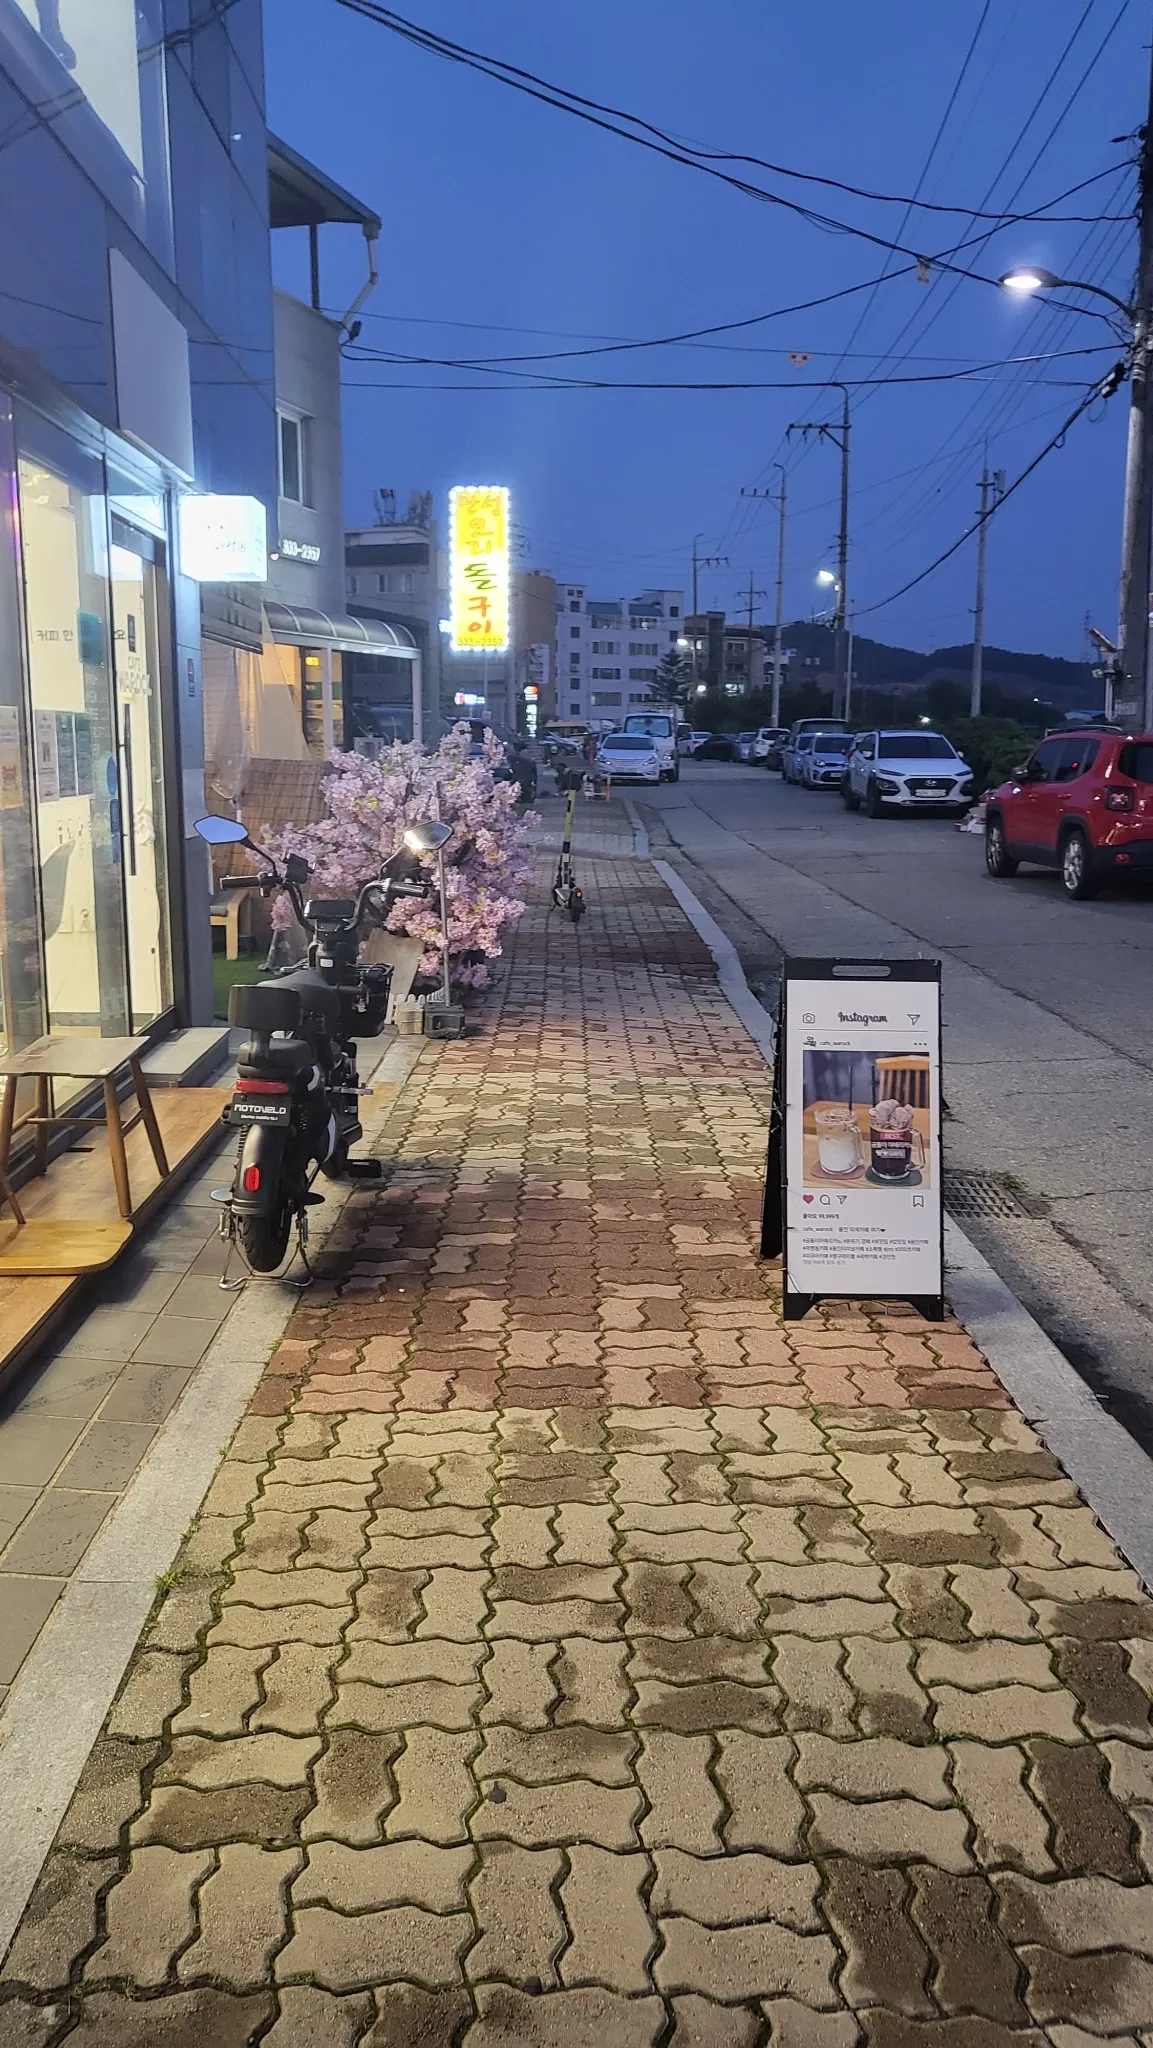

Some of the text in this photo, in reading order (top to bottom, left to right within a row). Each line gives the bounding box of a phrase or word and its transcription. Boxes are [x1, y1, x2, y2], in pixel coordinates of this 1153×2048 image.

[282, 539, 321, 562] 333-2357
[36, 629, 59, 642] 커피
[63, 629, 74, 642] 한
[457, 637, 503, 648] 333-2357
[838, 1011, 888, 1026] Instagram
[819, 1039, 851, 1047] cafe_warock
[234, 1104, 286, 1114] MOTOVELO
